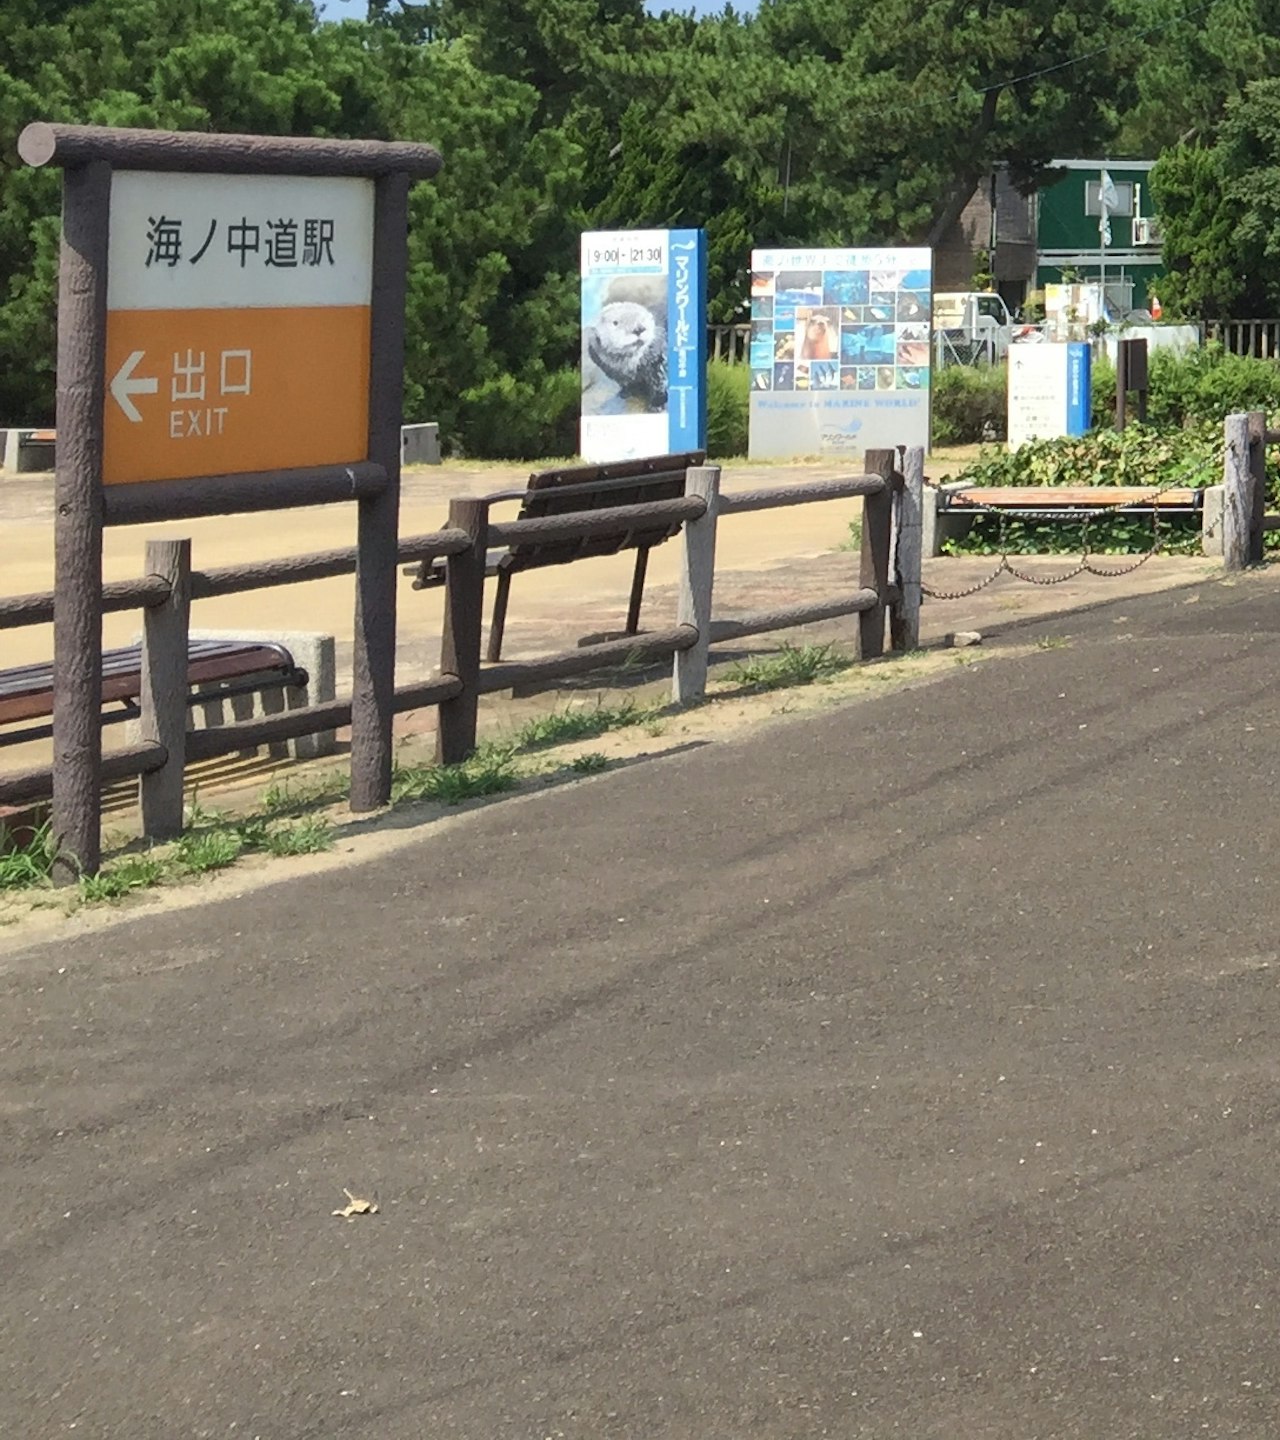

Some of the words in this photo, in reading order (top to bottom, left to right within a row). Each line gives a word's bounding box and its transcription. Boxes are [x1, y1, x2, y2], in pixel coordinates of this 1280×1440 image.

[145, 215, 335, 268] 海ノ中道駅
[171, 348, 252, 402] 出口
[170, 408, 228, 437] EXIT
